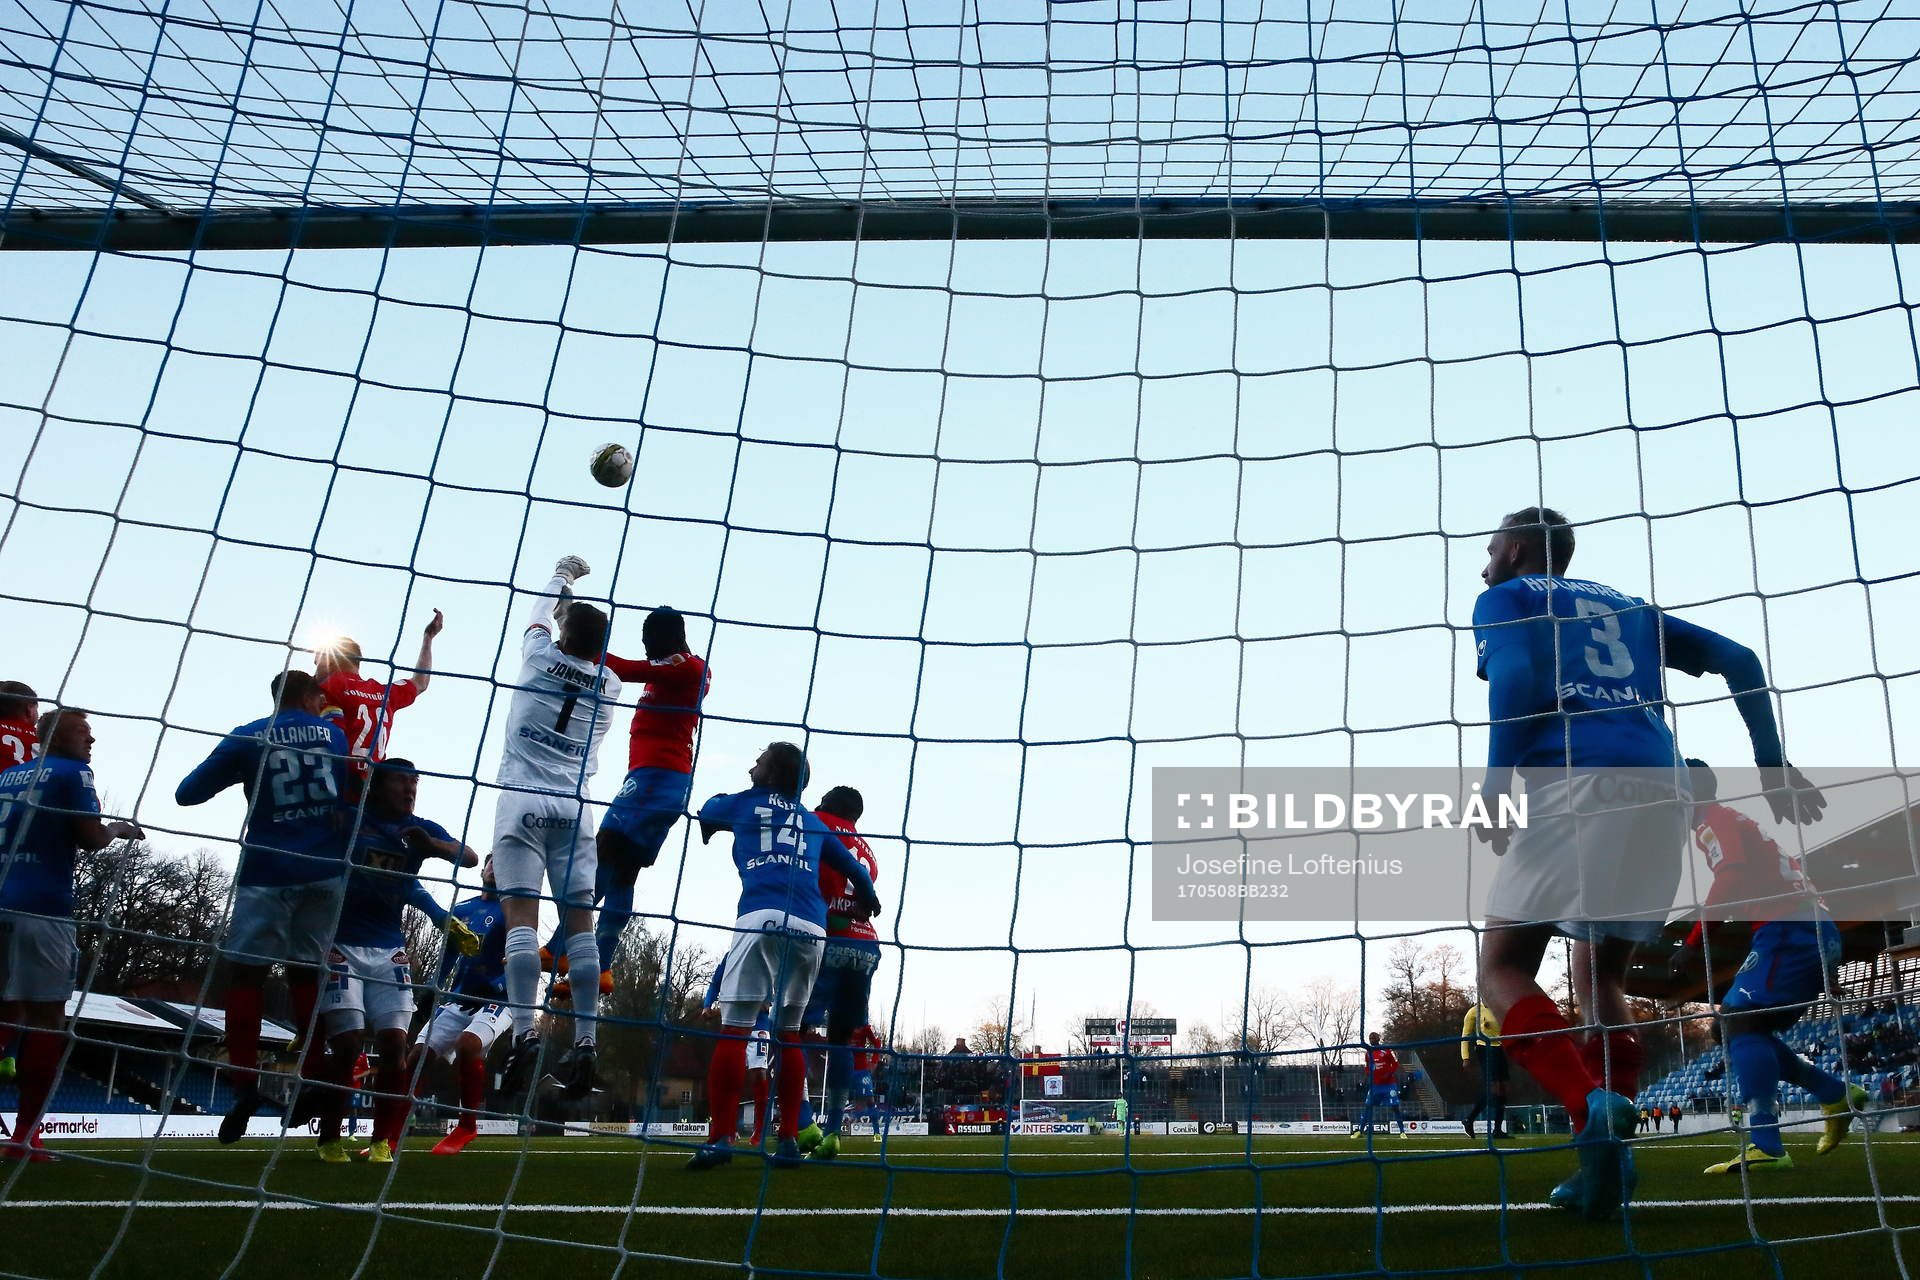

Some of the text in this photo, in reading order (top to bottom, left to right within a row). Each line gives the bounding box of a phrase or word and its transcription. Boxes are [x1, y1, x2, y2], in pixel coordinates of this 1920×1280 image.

[1575, 597, 1635, 679] 3
[268, 747, 338, 807] 23
[754, 806, 807, 856] 14
[672, 1123, 706, 1132] Rotakorn
[1023, 1124, 1085, 1133] INTERSPORT
[1172, 1124, 1198, 1133] ConLink
